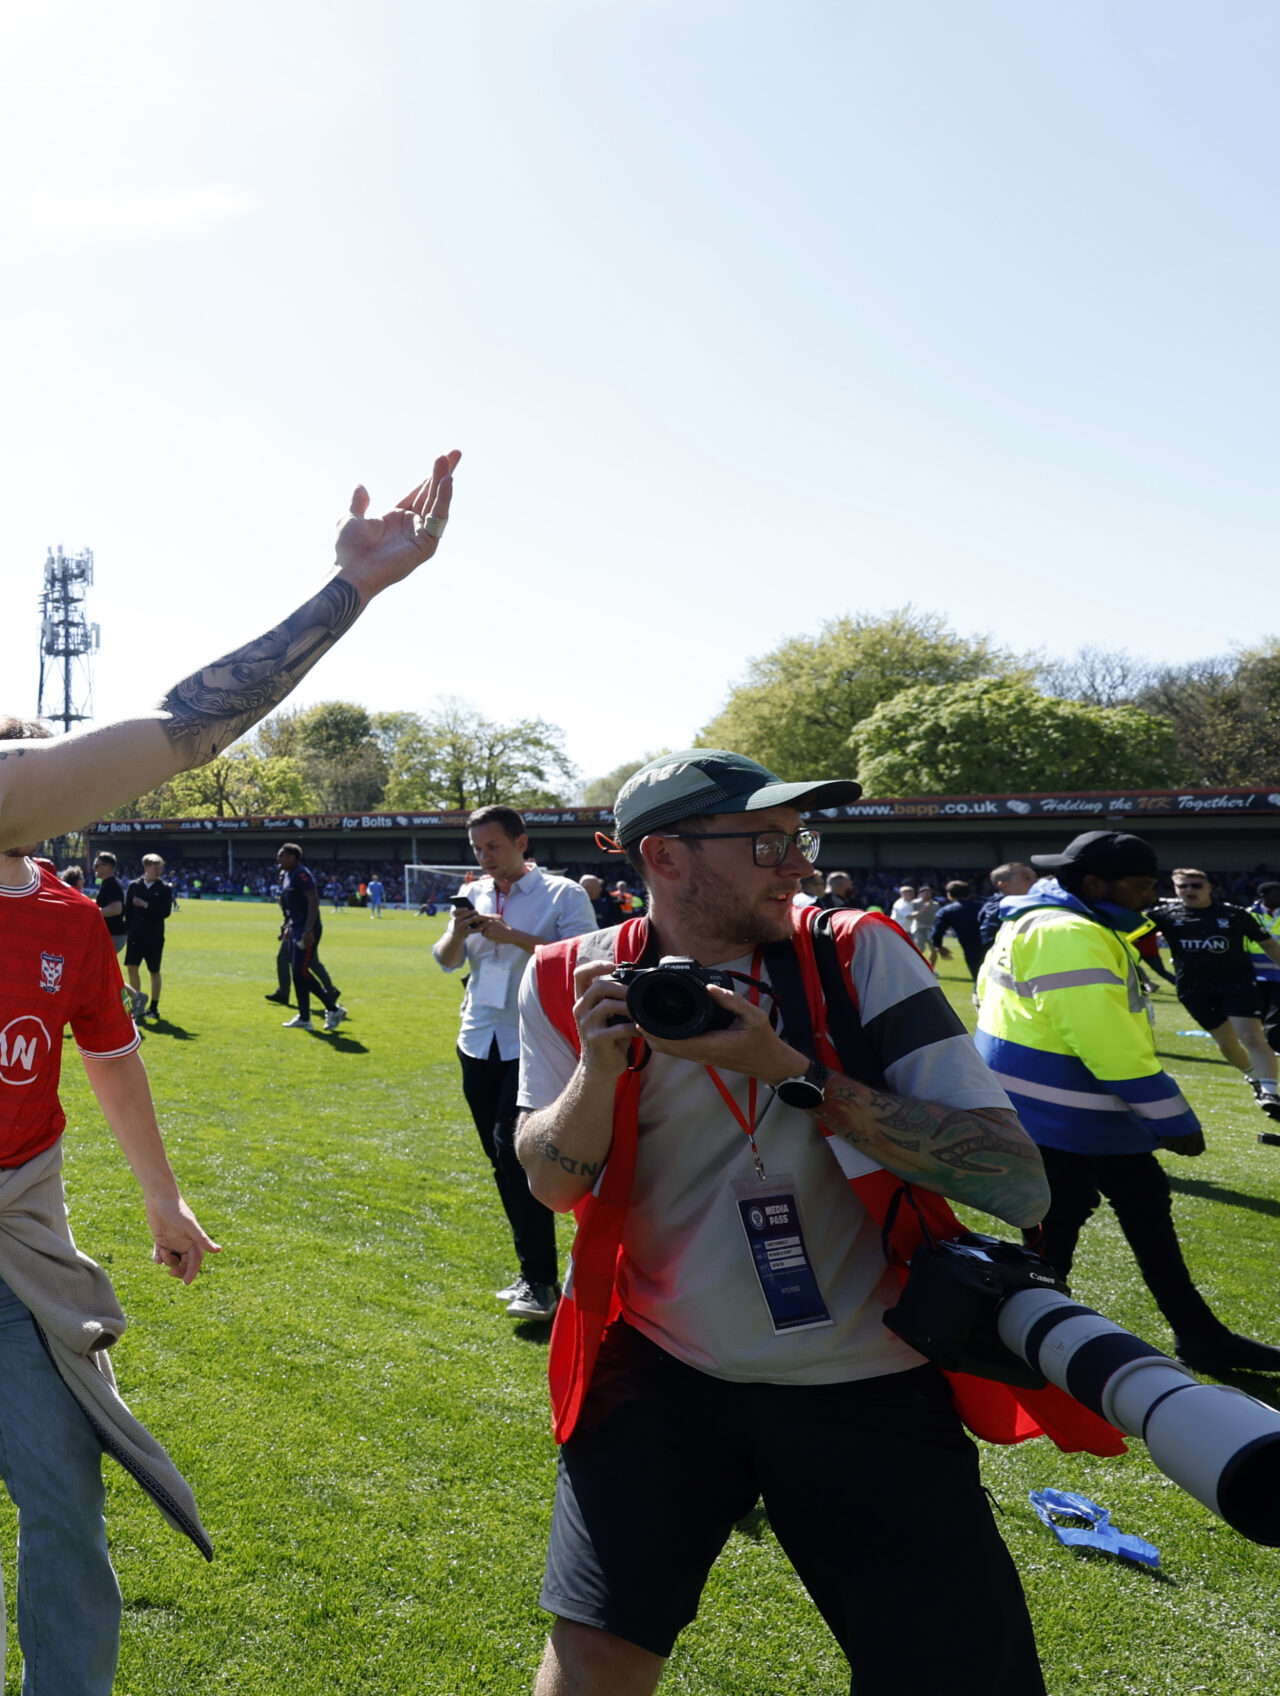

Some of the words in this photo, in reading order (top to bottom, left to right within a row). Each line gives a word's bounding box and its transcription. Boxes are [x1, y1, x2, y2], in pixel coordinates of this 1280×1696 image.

[845, 801, 998, 816] www.bapp.co.uk
[1040, 798, 1104, 813] Holding
[1109, 797, 1133, 810] the
[1137, 797, 1172, 809] UK
[1177, 794, 1256, 812] Together!
[308, 817, 340, 828] BAPP
[342, 816, 359, 828] for
[361, 815, 392, 827] Bolts
[413, 815, 467, 826] www.bapp
[98, 823, 109, 832] for
[110, 823, 131, 832] Bolts
[1180, 938, 1227, 950] TITAN
[764, 1204, 790, 1216] MEDIA
[769, 1214, 789, 1226] PASS
[1029, 1272, 1056, 1285] Canon
